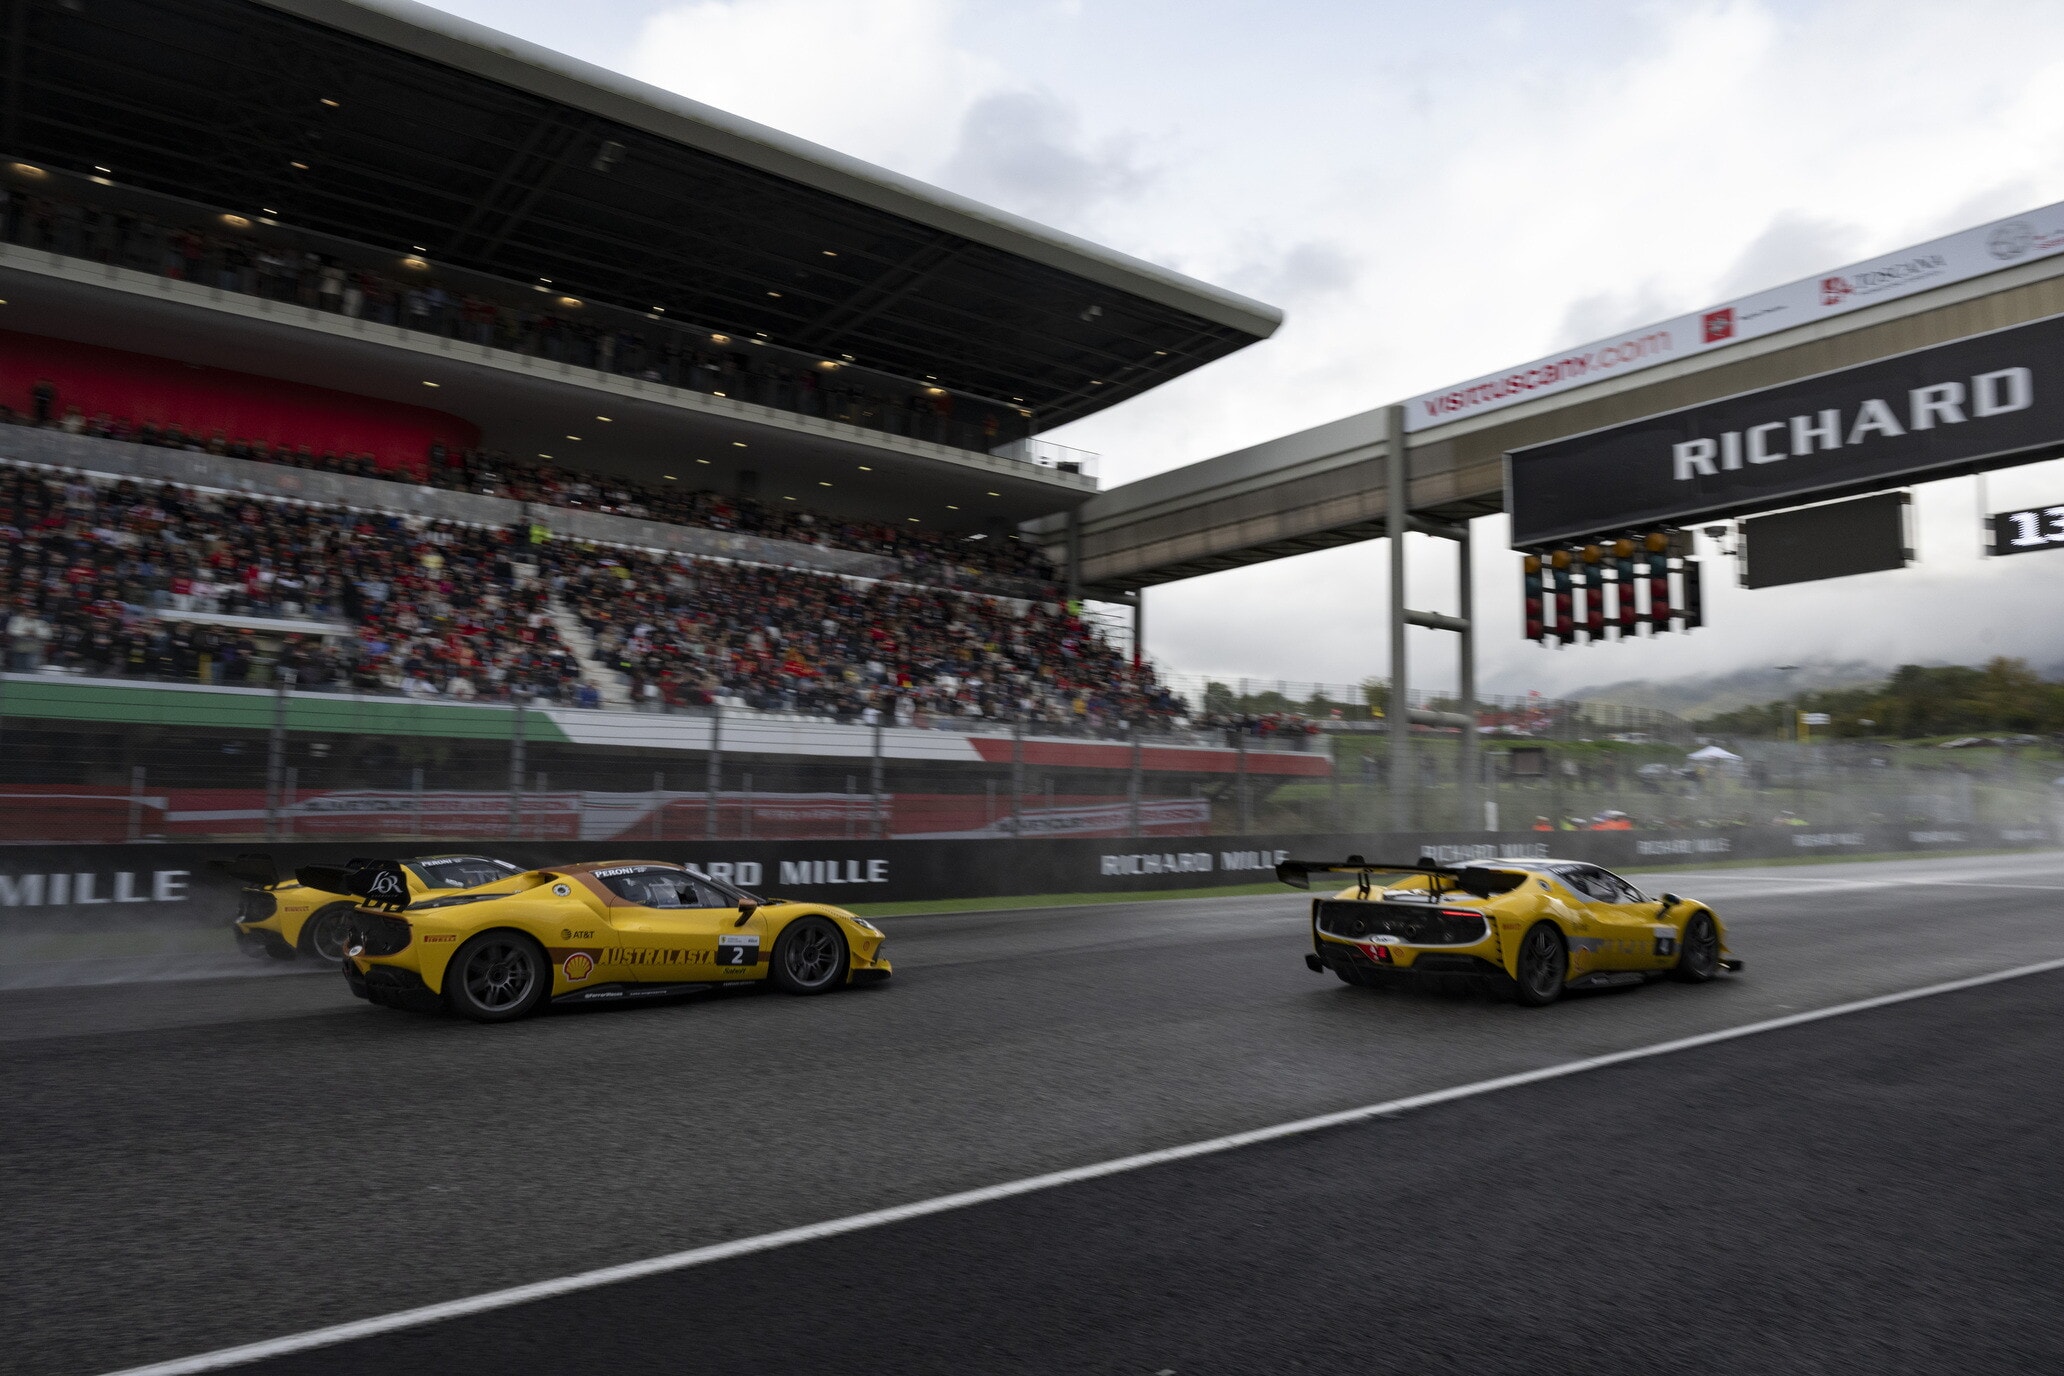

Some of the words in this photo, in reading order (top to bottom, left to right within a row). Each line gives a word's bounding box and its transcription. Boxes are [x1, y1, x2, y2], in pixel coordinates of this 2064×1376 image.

[1672, 366, 2034, 481] RICHARD
[594, 867, 633, 878] PERONI
[779, 859, 889, 885] MILLE
[1100, 853, 1213, 876] RICHARD
[1220, 849, 1290, 871] MILLE
[0, 870, 191, 907] MILLE
[573, 930, 595, 940] AT&T
[731, 946, 744, 965] 2
